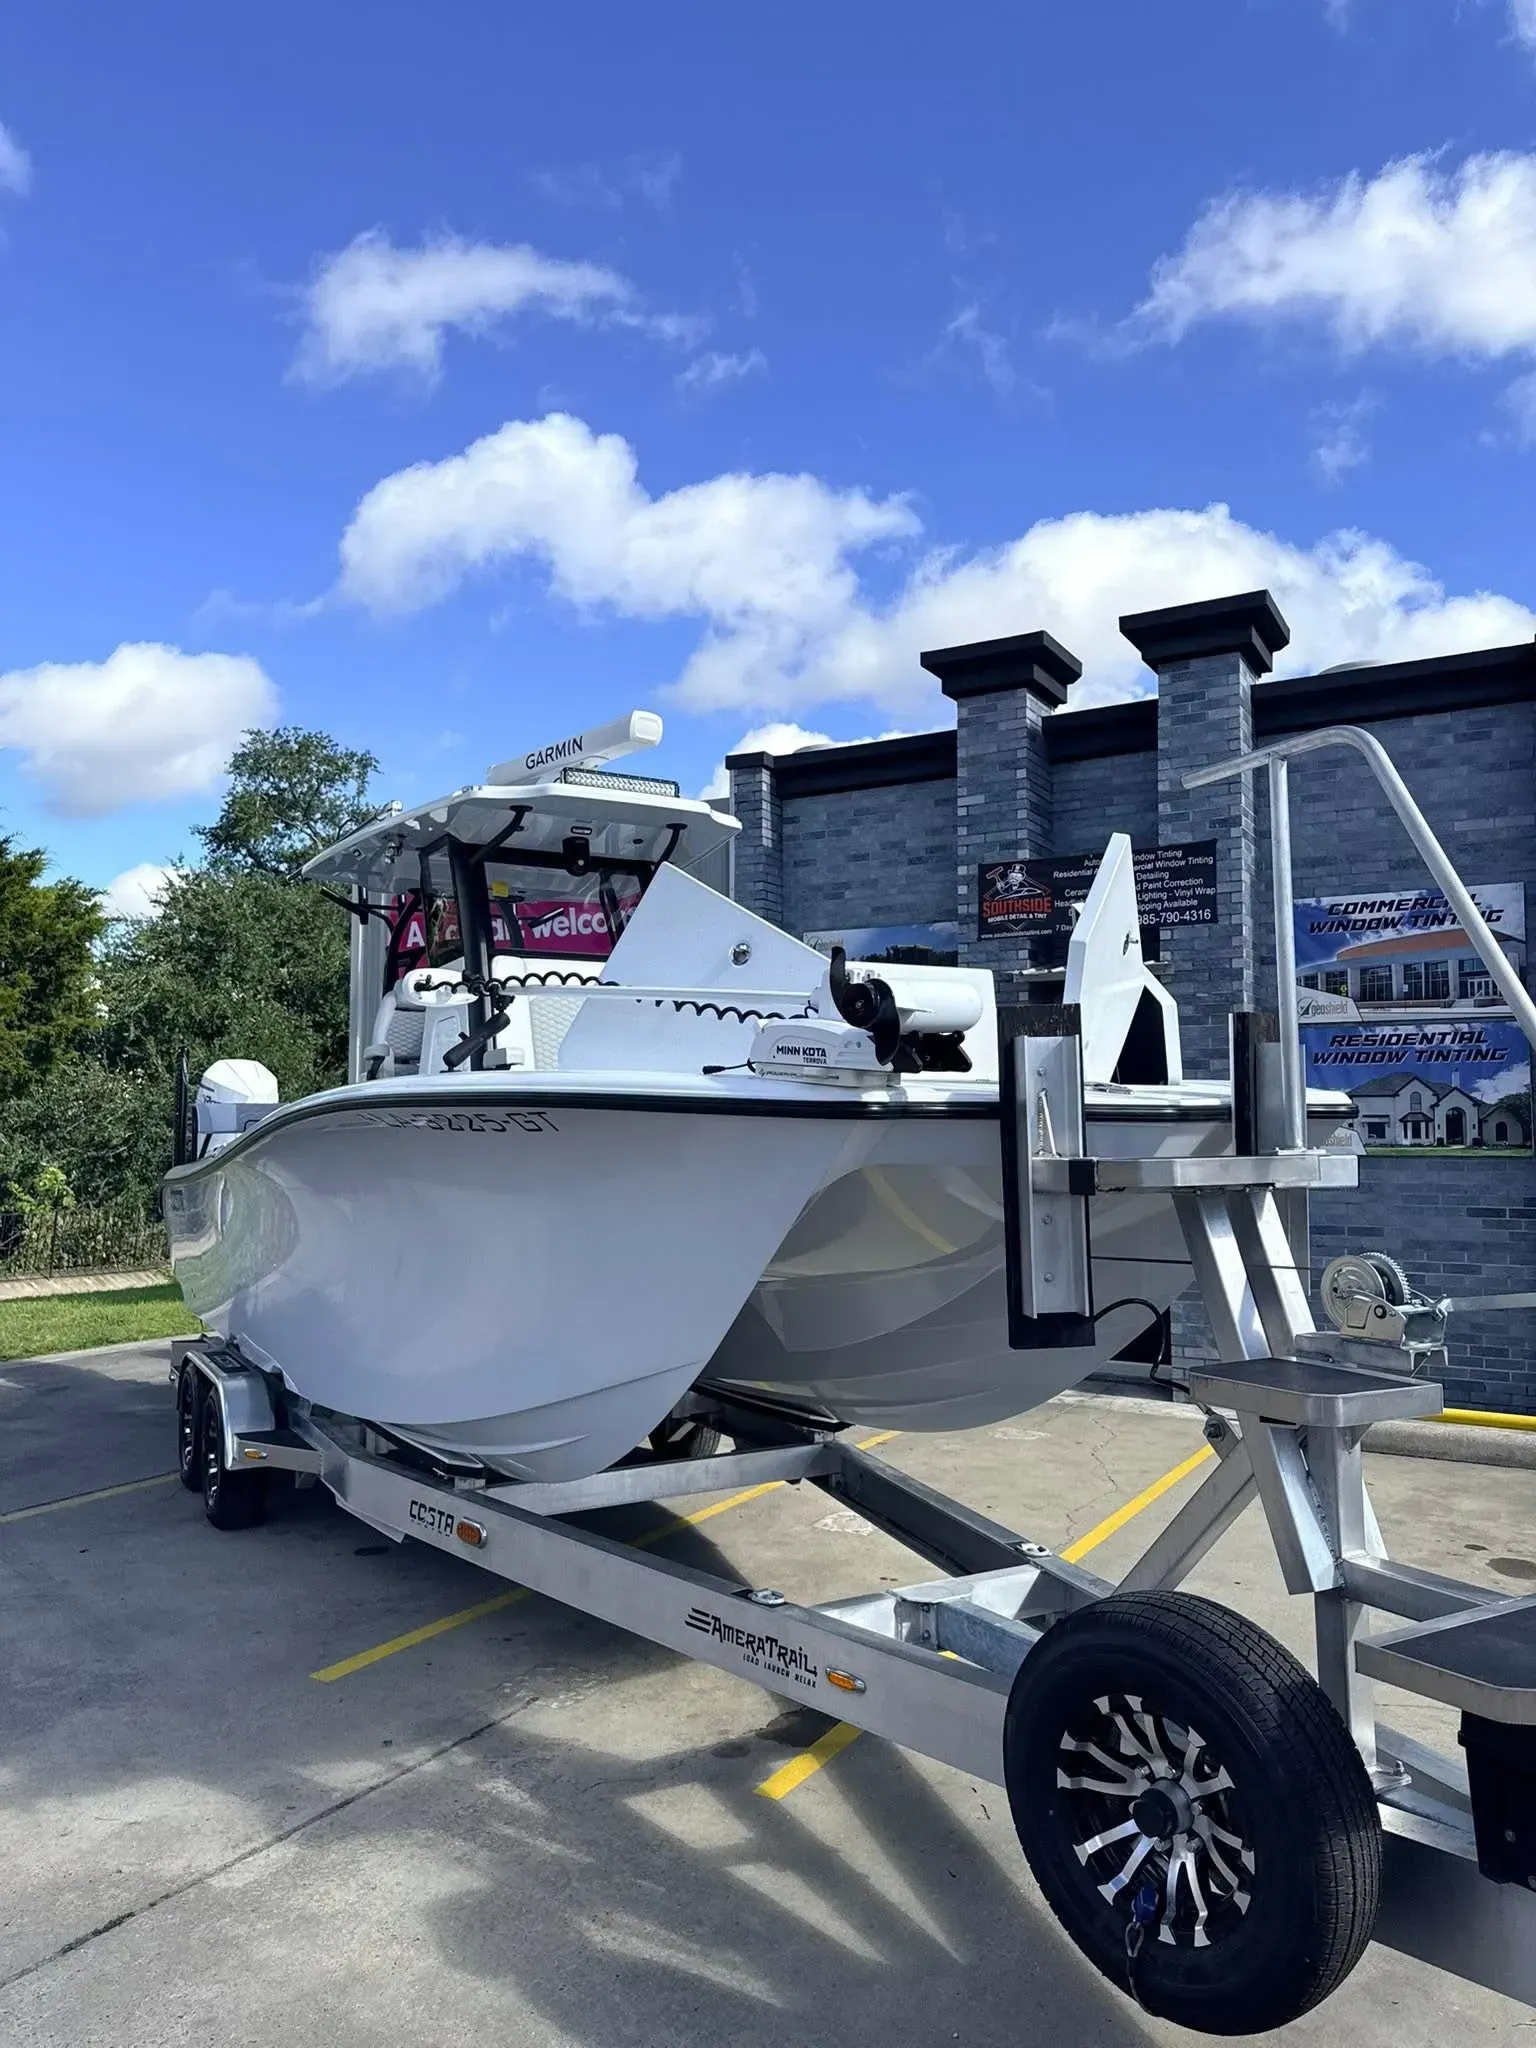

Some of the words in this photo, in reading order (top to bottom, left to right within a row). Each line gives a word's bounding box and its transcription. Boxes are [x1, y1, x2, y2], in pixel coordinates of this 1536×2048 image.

[525, 735, 584, 770] GARMIN
[1132, 852, 1155, 861] indow
[1157, 850, 1182, 859] Tinting
[1053, 868, 1093, 878] Residential
[1133, 862, 1154, 871] ercial
[1155, 860, 1186, 869] Window
[1188, 856, 1213, 865] Tinting
[1136, 871, 1169, 880] Detailing
[1064, 888, 1089, 897] Ceram
[1142, 881, 1162, 890] Paint
[1163, 878, 1204, 888] Correction
[1137, 891, 1167, 901] Lighting
[1174, 888, 1193, 898] Vinyl
[1194, 887, 1216, 896] Wrap
[983, 896, 1053, 918] SOUTHSIDE
[1163, 899, 1198, 909] Available
[988, 914, 1009, 923] MOBILE
[1138, 908, 1211, 925] 985-790-4316
[1308, 914, 1409, 935] WINDOW
[1411, 909, 1504, 930] TINTG
[1328, 1030, 1489, 1049] RESIDENTIAL
[776, 1045, 800, 1056] MINN
[802, 1046, 827, 1058] KOTA
[803, 1056, 828, 1065] TERROVA
[1312, 1049, 1412, 1066] WINDOW
[1415, 1048, 1509, 1064] TINTING
[409, 1499, 456, 1535] COSTA
[743, 1653, 760, 1666] LOAD
[764, 1661, 791, 1678] LAUNCH
[794, 1673, 817, 1689] RELAX
